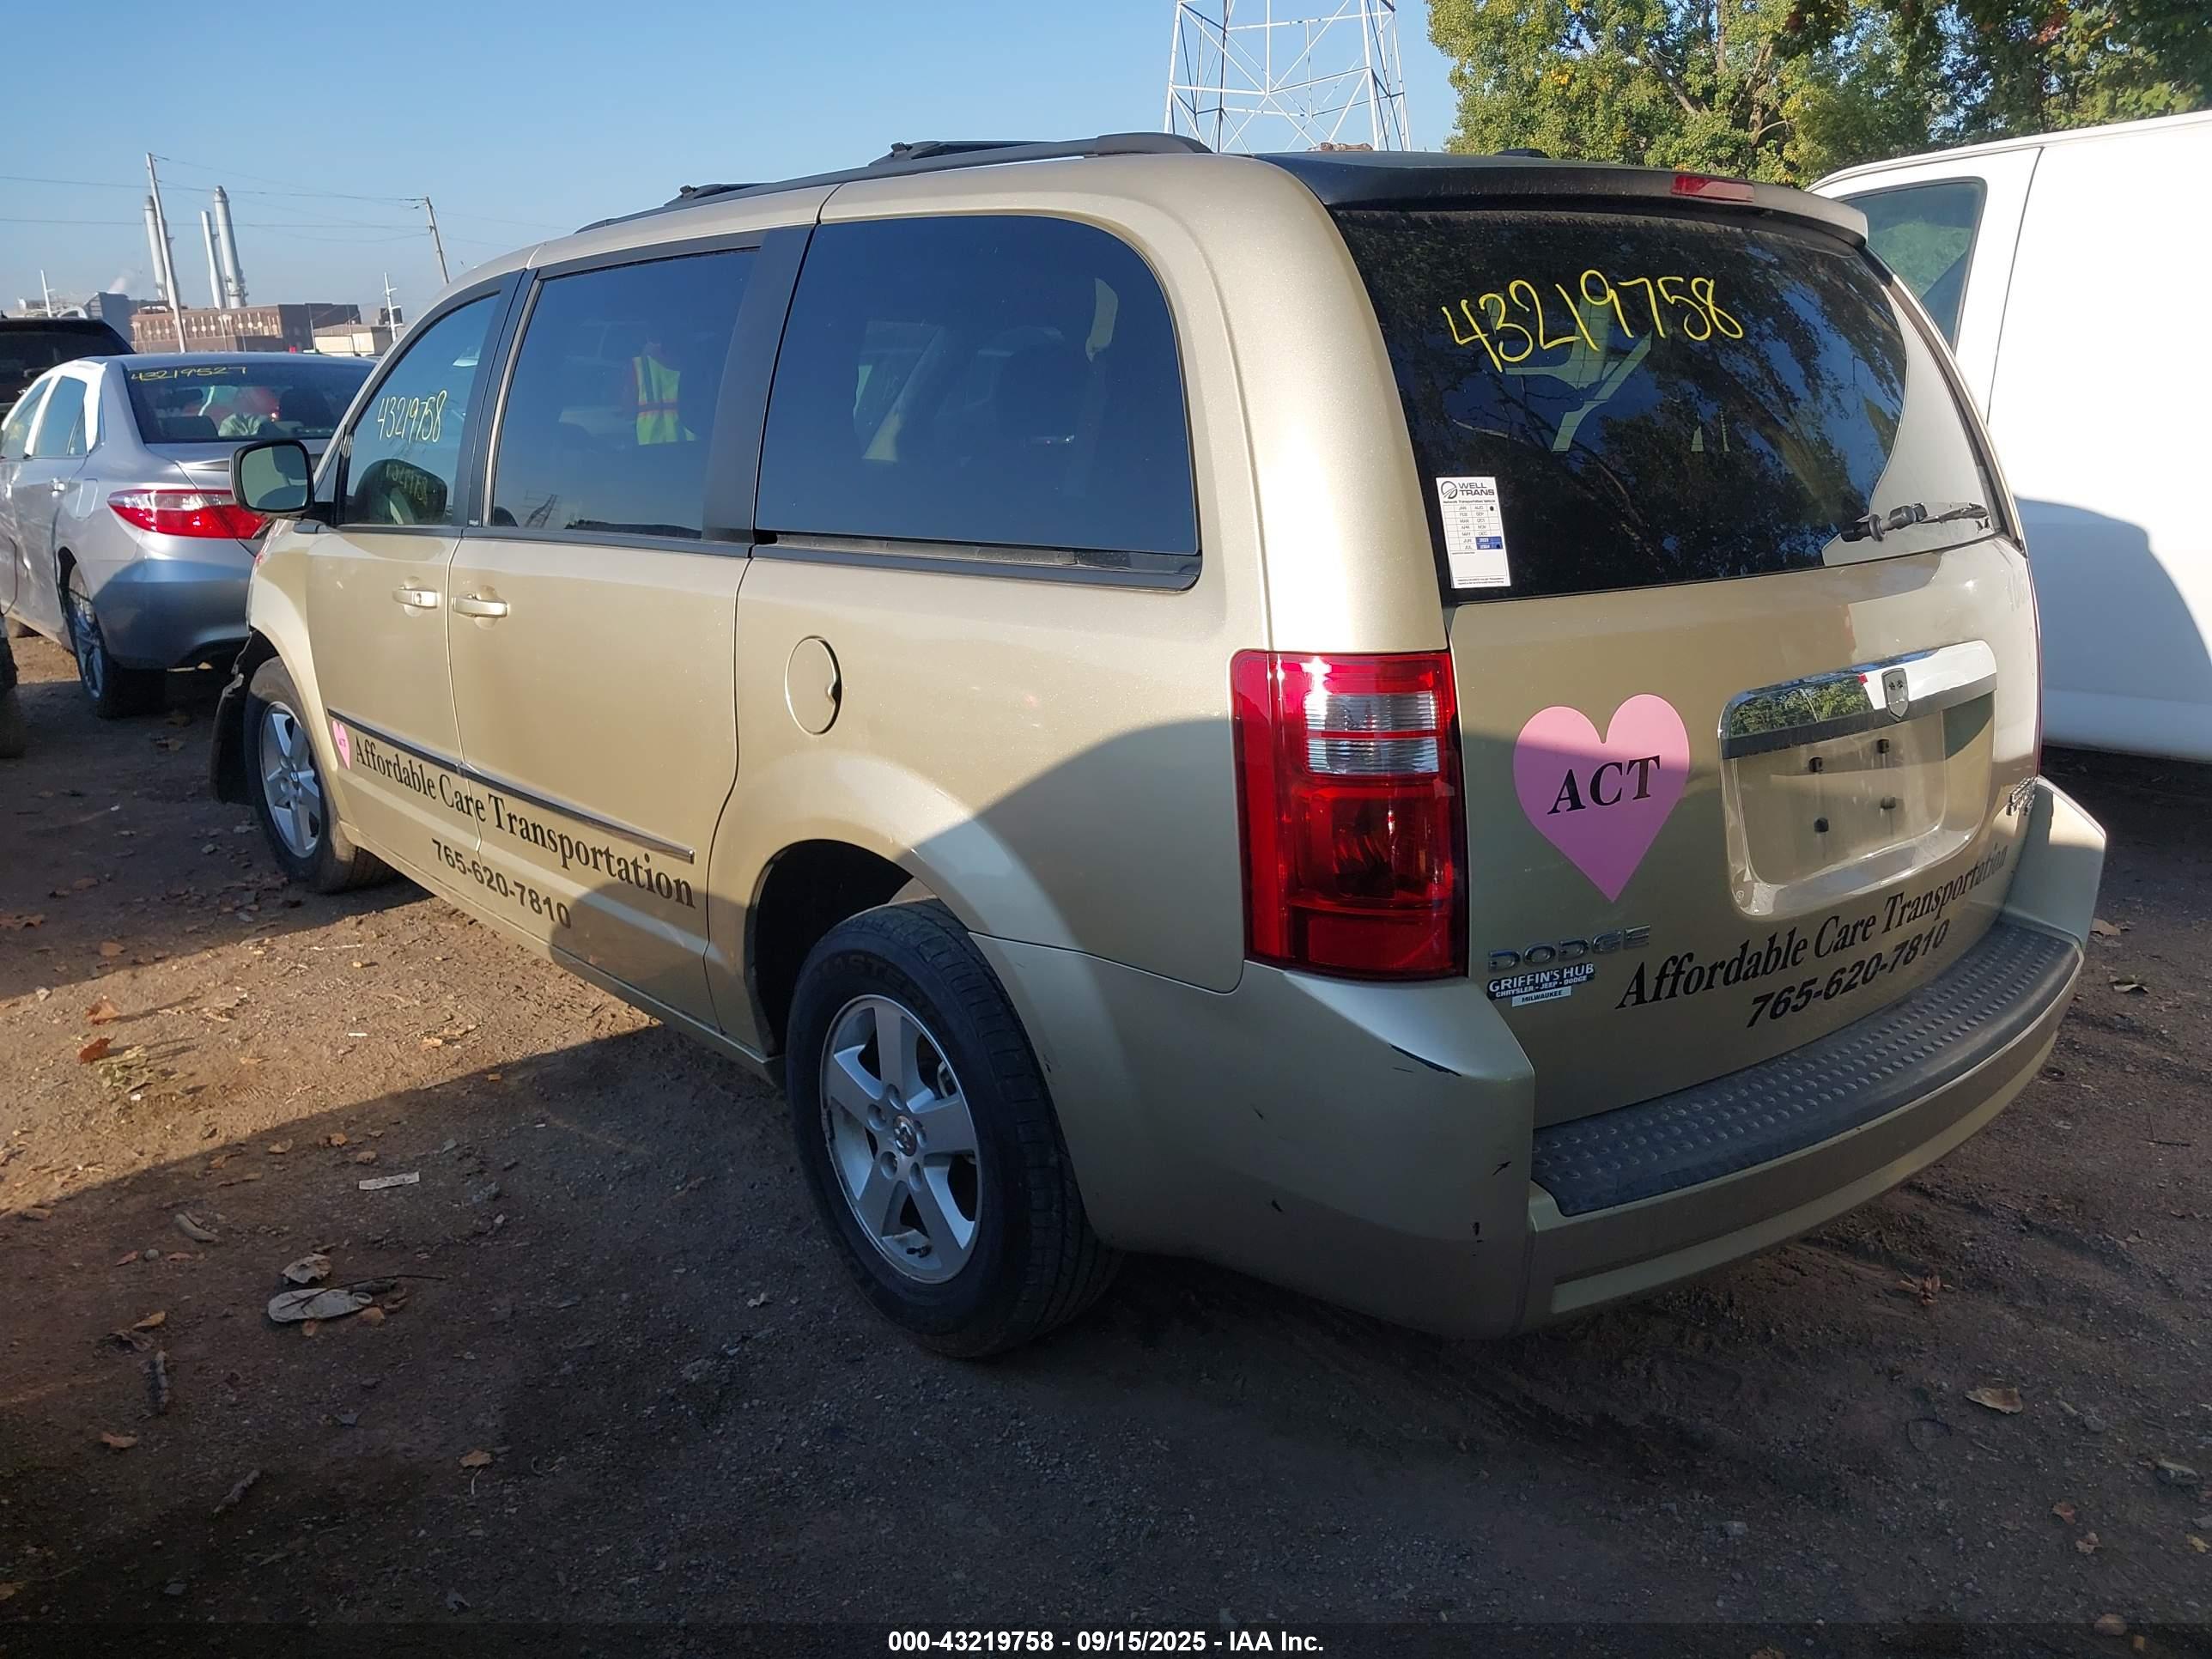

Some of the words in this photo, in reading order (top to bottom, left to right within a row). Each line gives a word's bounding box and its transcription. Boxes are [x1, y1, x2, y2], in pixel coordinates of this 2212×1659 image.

[1441, 270, 1744, 373] 43219758
[377, 389, 447, 445] 43219758
[1547, 755, 1661, 815] ACT
[355, 735, 437, 799] Affordable
[439, 774, 487, 823] Care
[488, 793, 696, 909] Transportation
[431, 837, 572, 929] 765-620-7810
[1488, 924, 1650, 973] DODGE
[1614, 927, 1808, 1009] Affordable
[1814, 915, 1877, 957] Care
[1881, 842, 2008, 933] Transportation
[1489, 969, 1560, 992] GRIFFIN'S
[1563, 963, 1595, 978] HUB
[1495, 985, 1534, 998] CHRYSLER
[1540, 981, 1558, 989] JEEP
[1564, 975, 1588, 985] DODGE
[1521, 989, 1564, 1003] MILWAUKEE
[1745, 919, 1951, 1029] 765-620-7810
